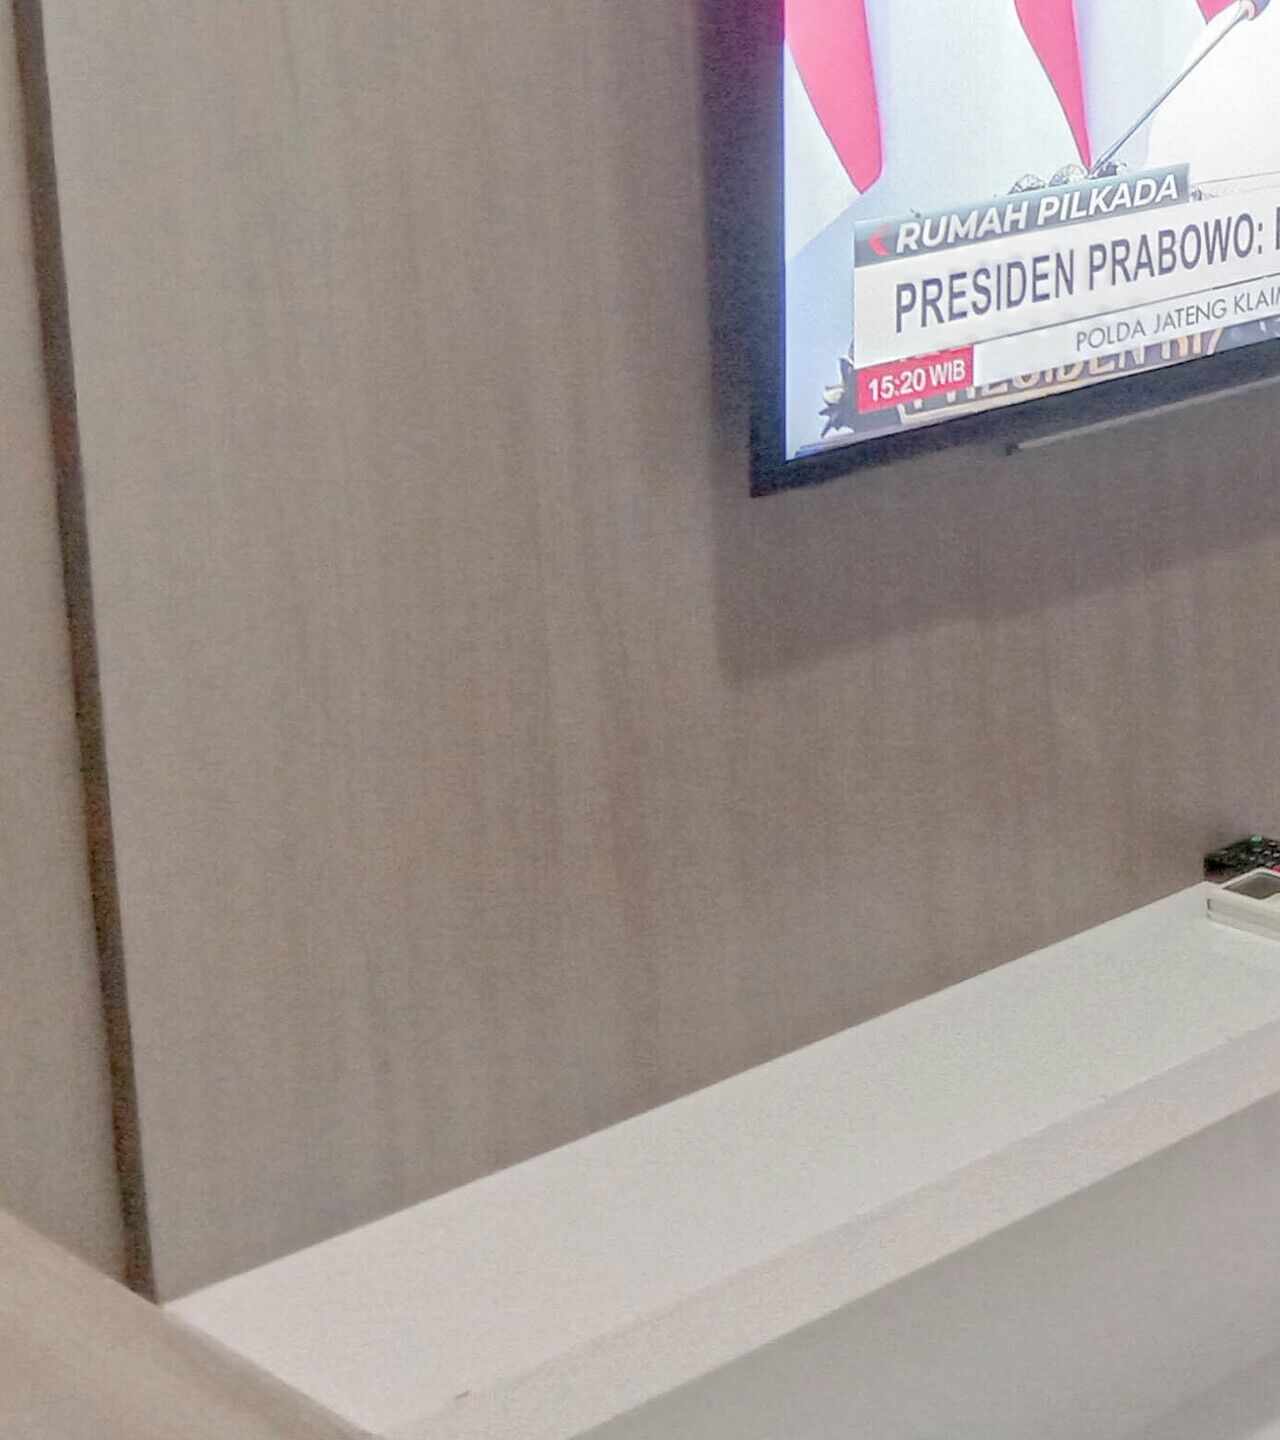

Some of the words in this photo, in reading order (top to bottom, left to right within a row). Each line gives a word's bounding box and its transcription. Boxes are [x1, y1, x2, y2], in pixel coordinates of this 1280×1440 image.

[895, 199, 1030, 255] RUMAH
[1037, 173, 1179, 227] PILKADA
[895, 249, 1075, 334] PRESIDEN
[1088, 213, 1263, 291] PRABOWO:
[1076, 321, 1146, 352] POLDA
[1154, 298, 1226, 334] JATENG
[868, 366, 926, 402] 15:20
[929, 359, 967, 387] WIB
